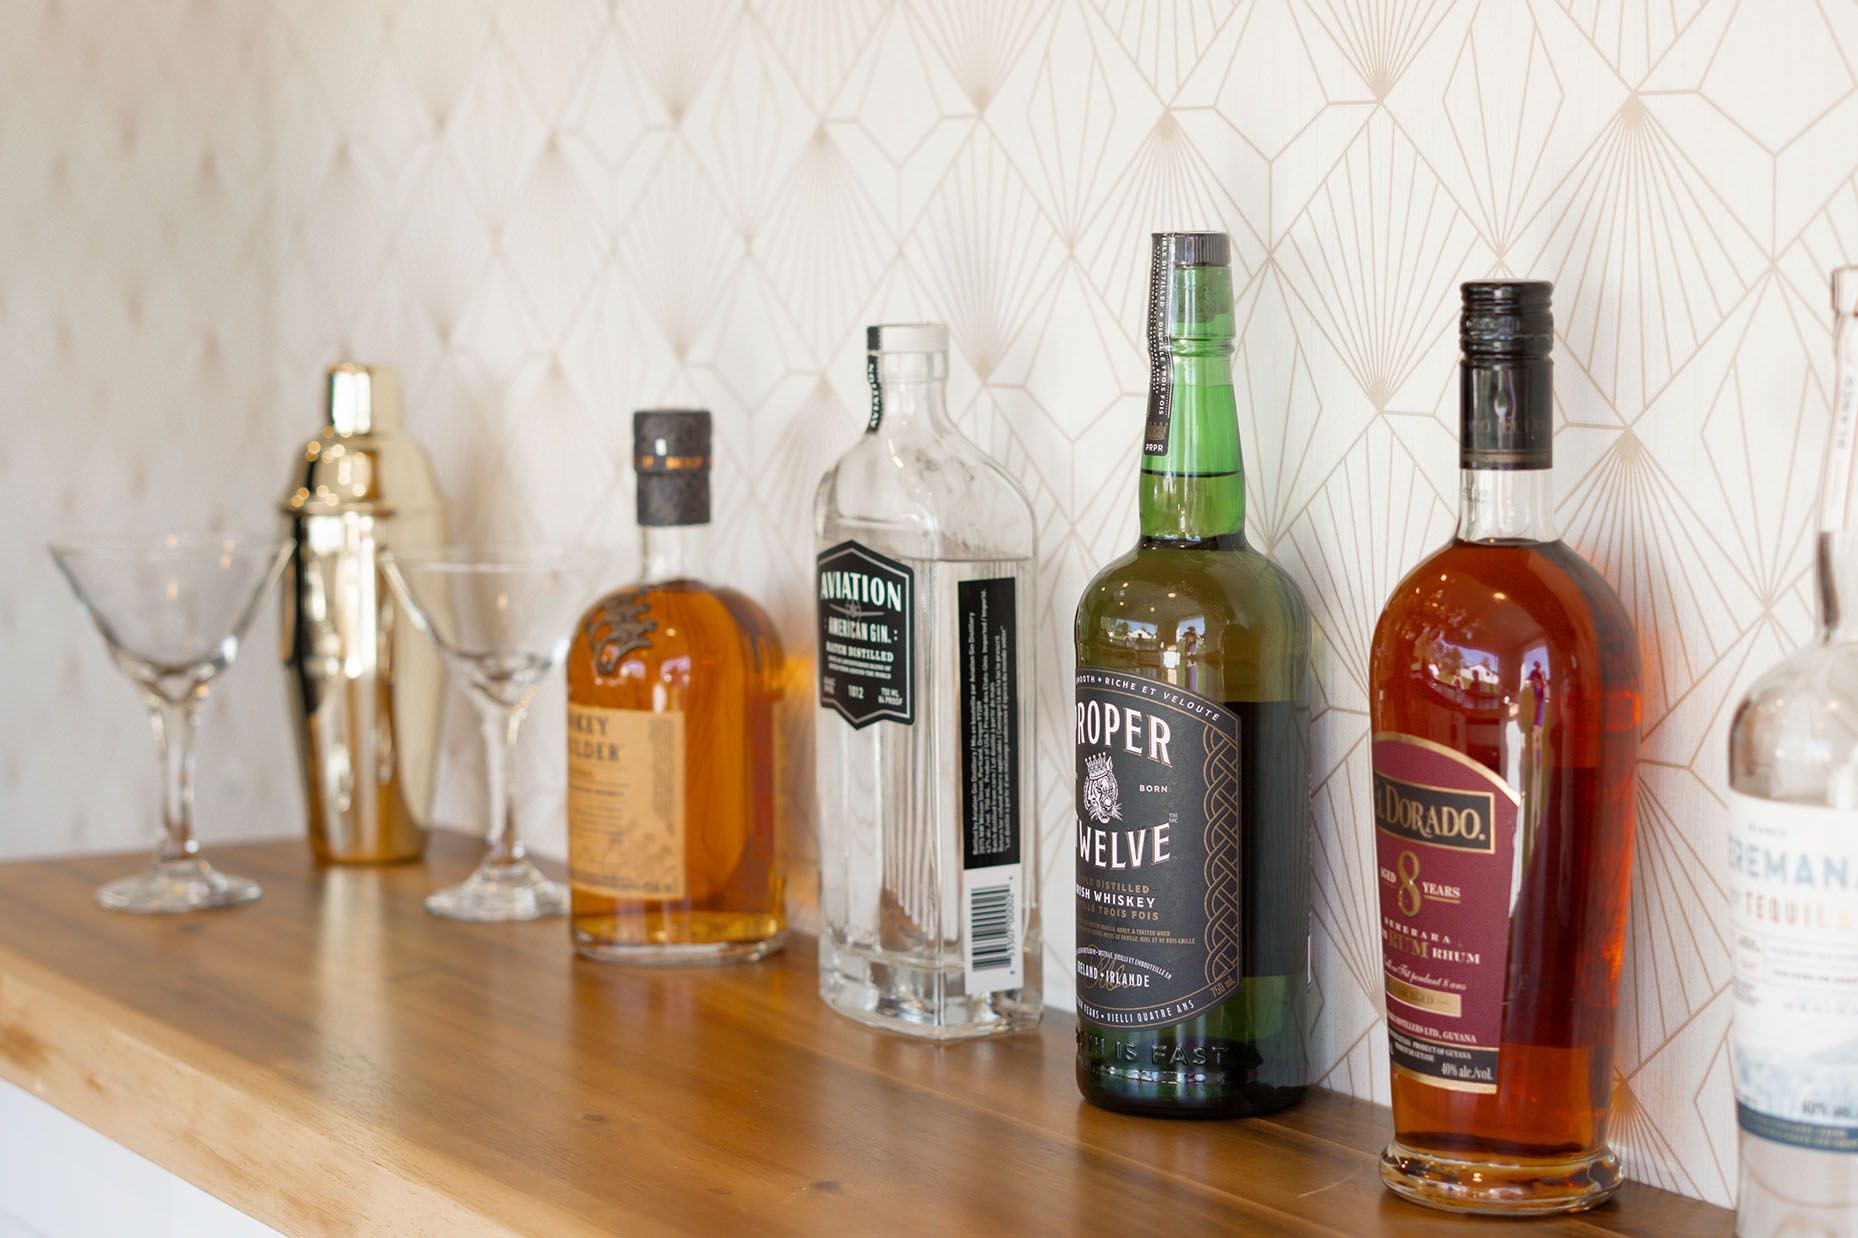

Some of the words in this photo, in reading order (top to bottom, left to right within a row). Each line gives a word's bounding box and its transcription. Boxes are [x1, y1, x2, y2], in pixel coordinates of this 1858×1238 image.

[1145, 443, 1164, 452] PRPR
[820, 570, 902, 612] AVIATION
[828, 616, 868, 642] AMERICAN
[848, 646, 894, 663] DISTILLED
[1104, 677, 1136, 690] RICHE
[1142, 686, 1156, 696] ET
[1163, 692, 1220, 721] VELOUTE
[1076, 700, 1173, 768] ROPER
[1139, 784, 1168, 793] BORN
[1077, 818, 1170, 869] WELVE
[1096, 880, 1150, 894] DISTILLED
[1380, 866, 1396, 884] AGED
[1422, 881, 1461, 898] YEARS
[1398, 850, 1421, 917] 8
[1094, 890, 1156, 908] WHISKEY
[1098, 906, 1127, 918] TROIS
[1132, 910, 1159, 921] FOIS
[1389, 930, 1429, 960] RUM
[1432, 947, 1480, 965] RHUM
[1106, 970, 1150, 987] IRLANDE
[1449, 982, 1466, 990] ans
[1210, 982, 1225, 998] 750
[1138, 1008, 1172, 1022] QUATRE
[1177, 1000, 1195, 1013] ANS
[1443, 1031, 1477, 1043] GUYANA
[1151, 1043, 1229, 1065] FAST
[1445, 1049, 1471, 1060] GUYANA
[1442, 1062, 1458, 1076] 40%
